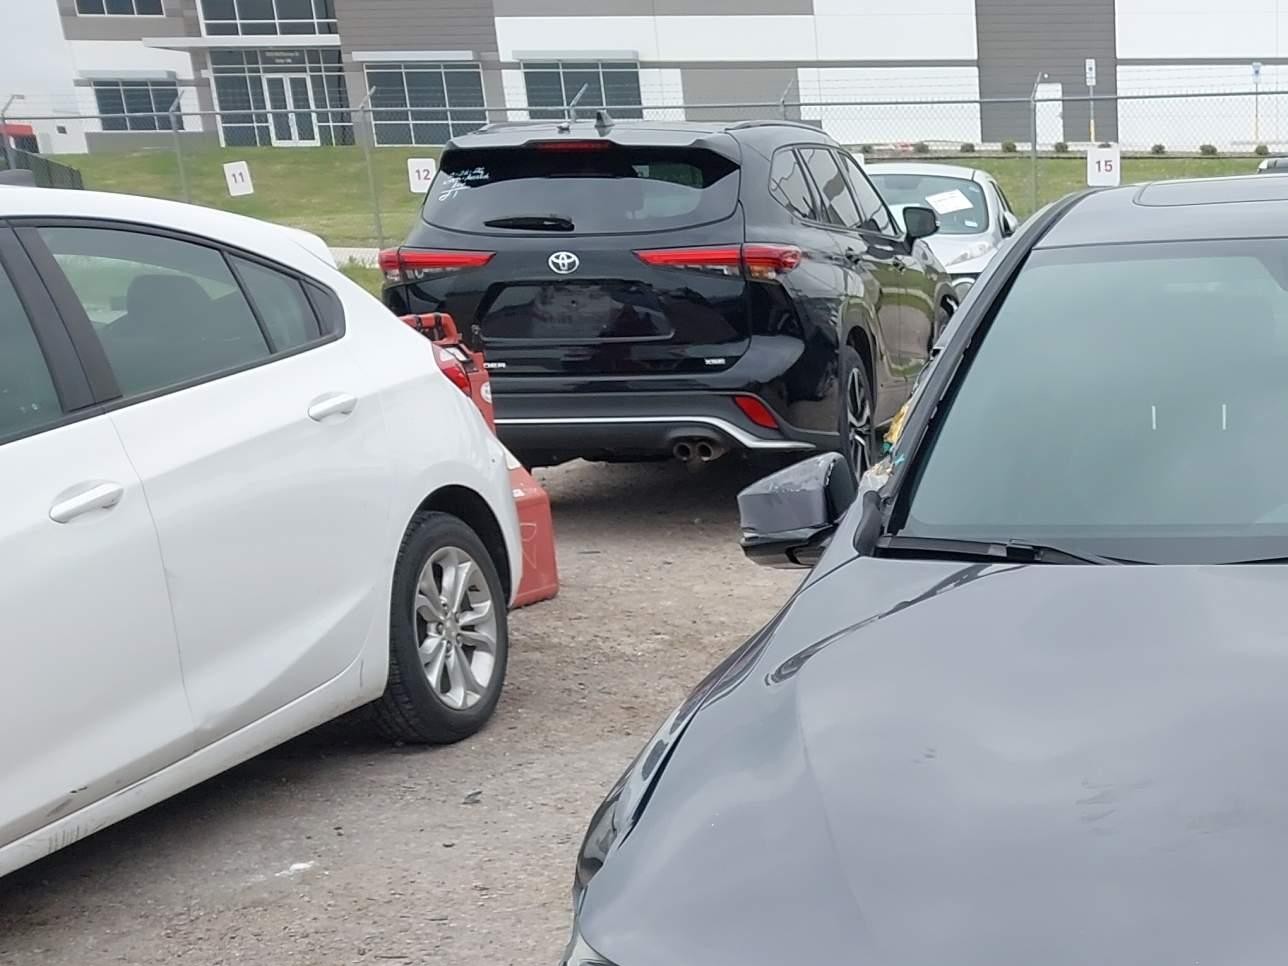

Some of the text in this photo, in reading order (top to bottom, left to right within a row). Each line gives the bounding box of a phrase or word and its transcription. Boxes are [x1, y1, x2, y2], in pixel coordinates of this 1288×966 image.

[1095, 159, 1113, 173] 15
[231, 171, 245, 184] 11
[415, 168, 432, 181] 12
